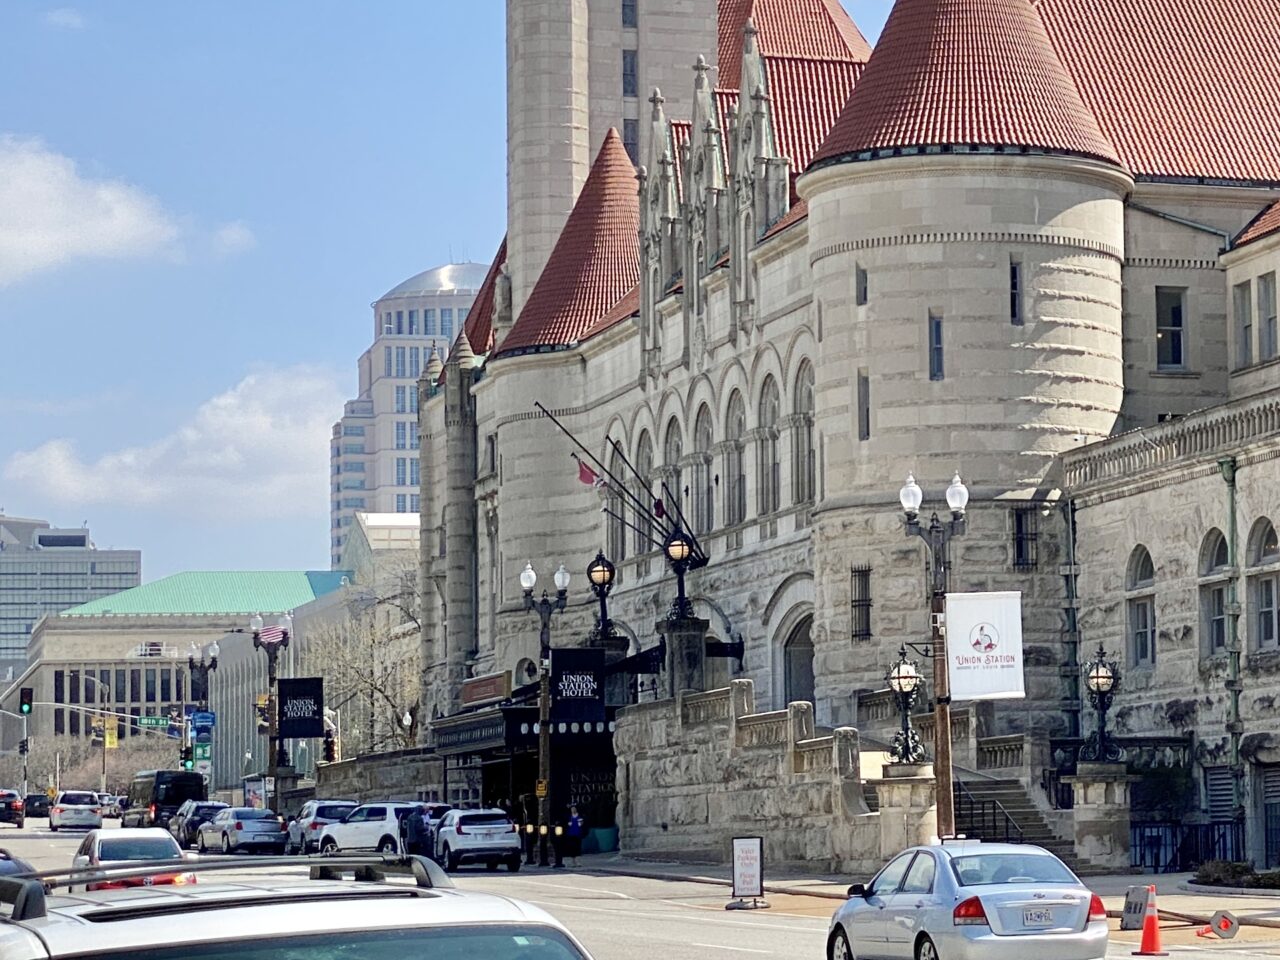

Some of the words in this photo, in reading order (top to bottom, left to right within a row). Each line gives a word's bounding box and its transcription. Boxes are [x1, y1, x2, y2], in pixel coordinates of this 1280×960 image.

[563, 675, 593, 683] UNION
[558, 682, 597, 690] STATION
[563, 689, 594, 697] HOTEL
[284, 704, 317, 712] STATION
